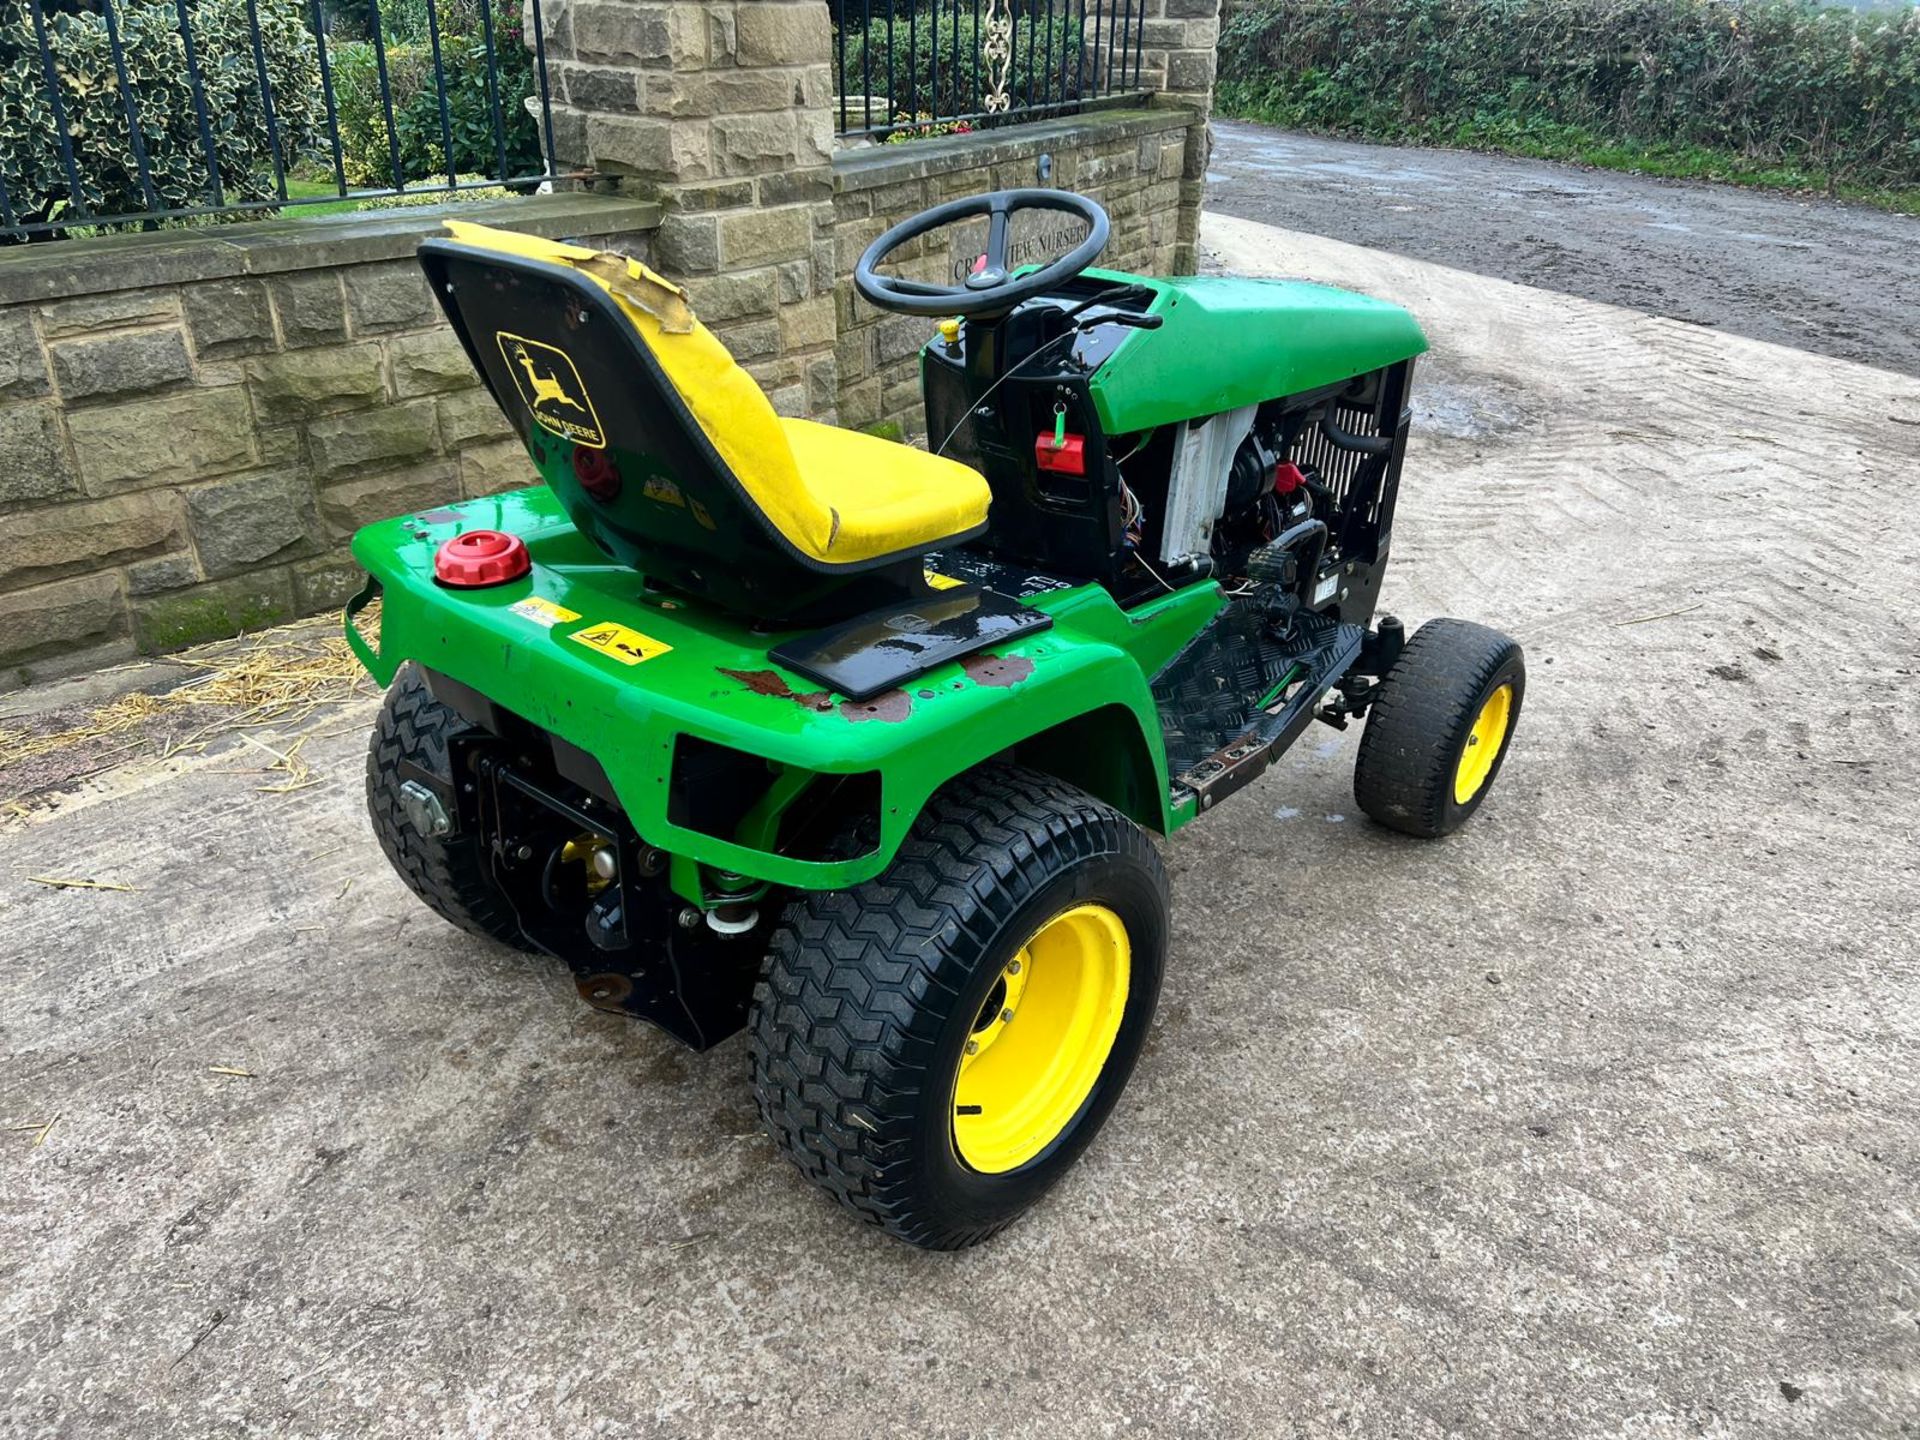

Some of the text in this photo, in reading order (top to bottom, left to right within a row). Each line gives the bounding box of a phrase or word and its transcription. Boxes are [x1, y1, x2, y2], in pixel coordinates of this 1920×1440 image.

[1039, 223, 1089, 256] NURSERI
[535, 411, 600, 441] JOHN DEERE
